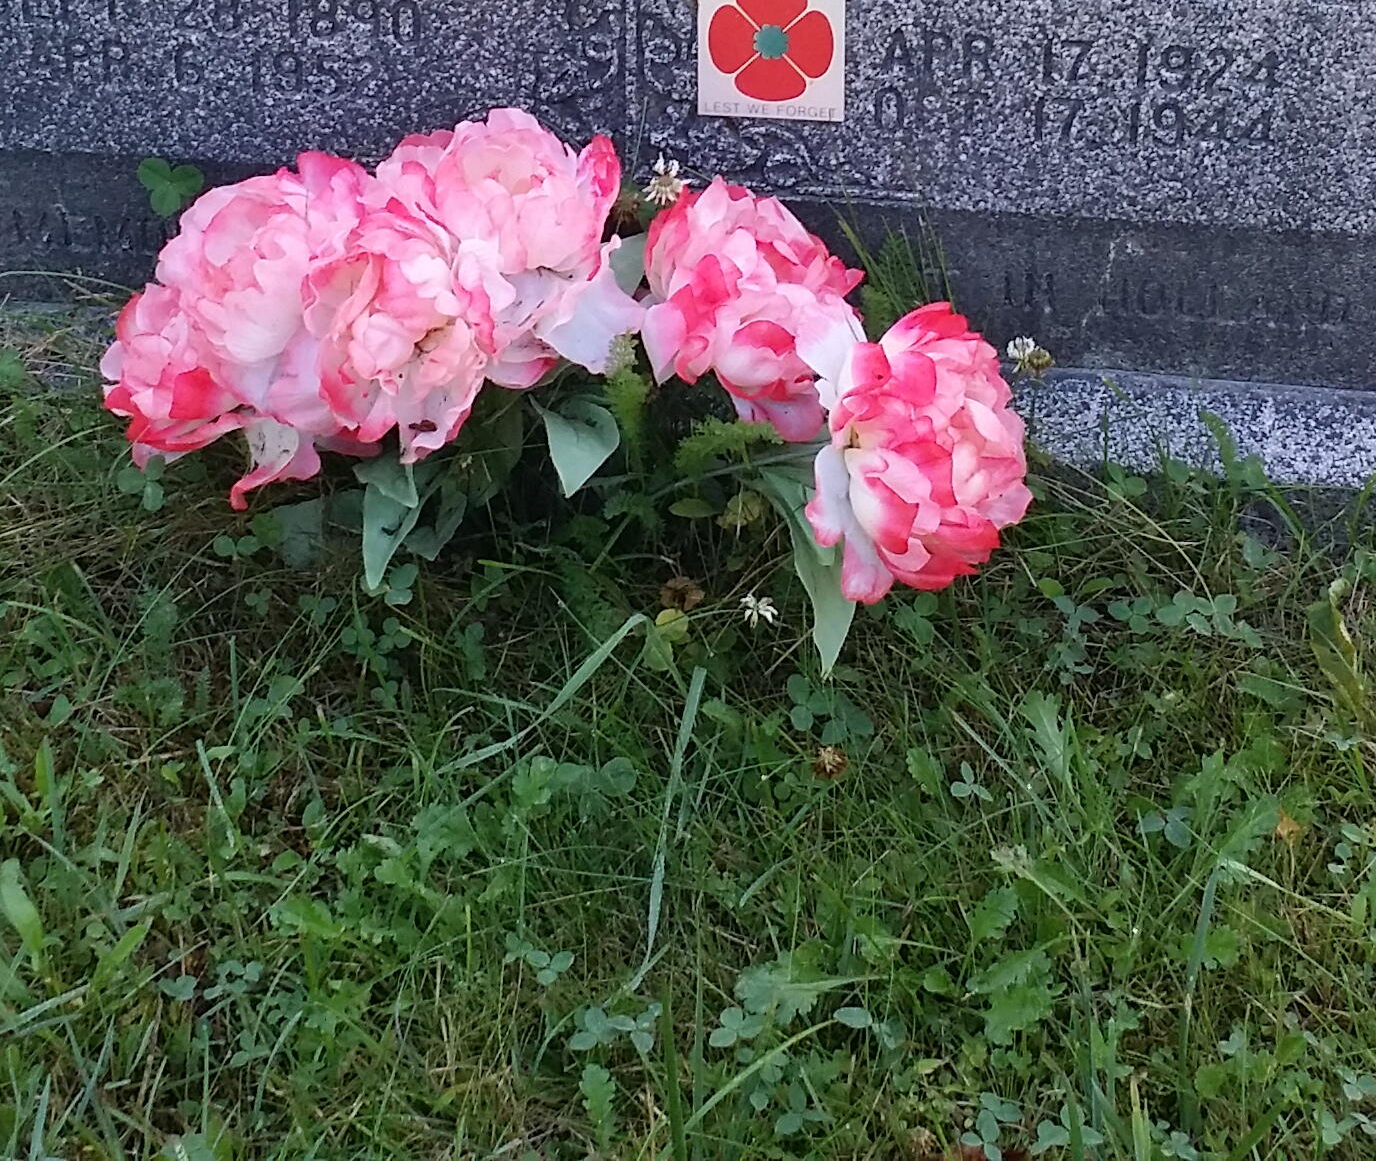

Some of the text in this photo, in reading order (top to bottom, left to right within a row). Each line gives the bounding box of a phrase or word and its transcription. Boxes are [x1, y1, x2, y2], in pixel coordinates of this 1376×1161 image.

[1135, 32, 1283, 92] 1924
[704, 101, 837, 121] LEST WE FORGET
[1126, 95, 1276, 147] 1944
